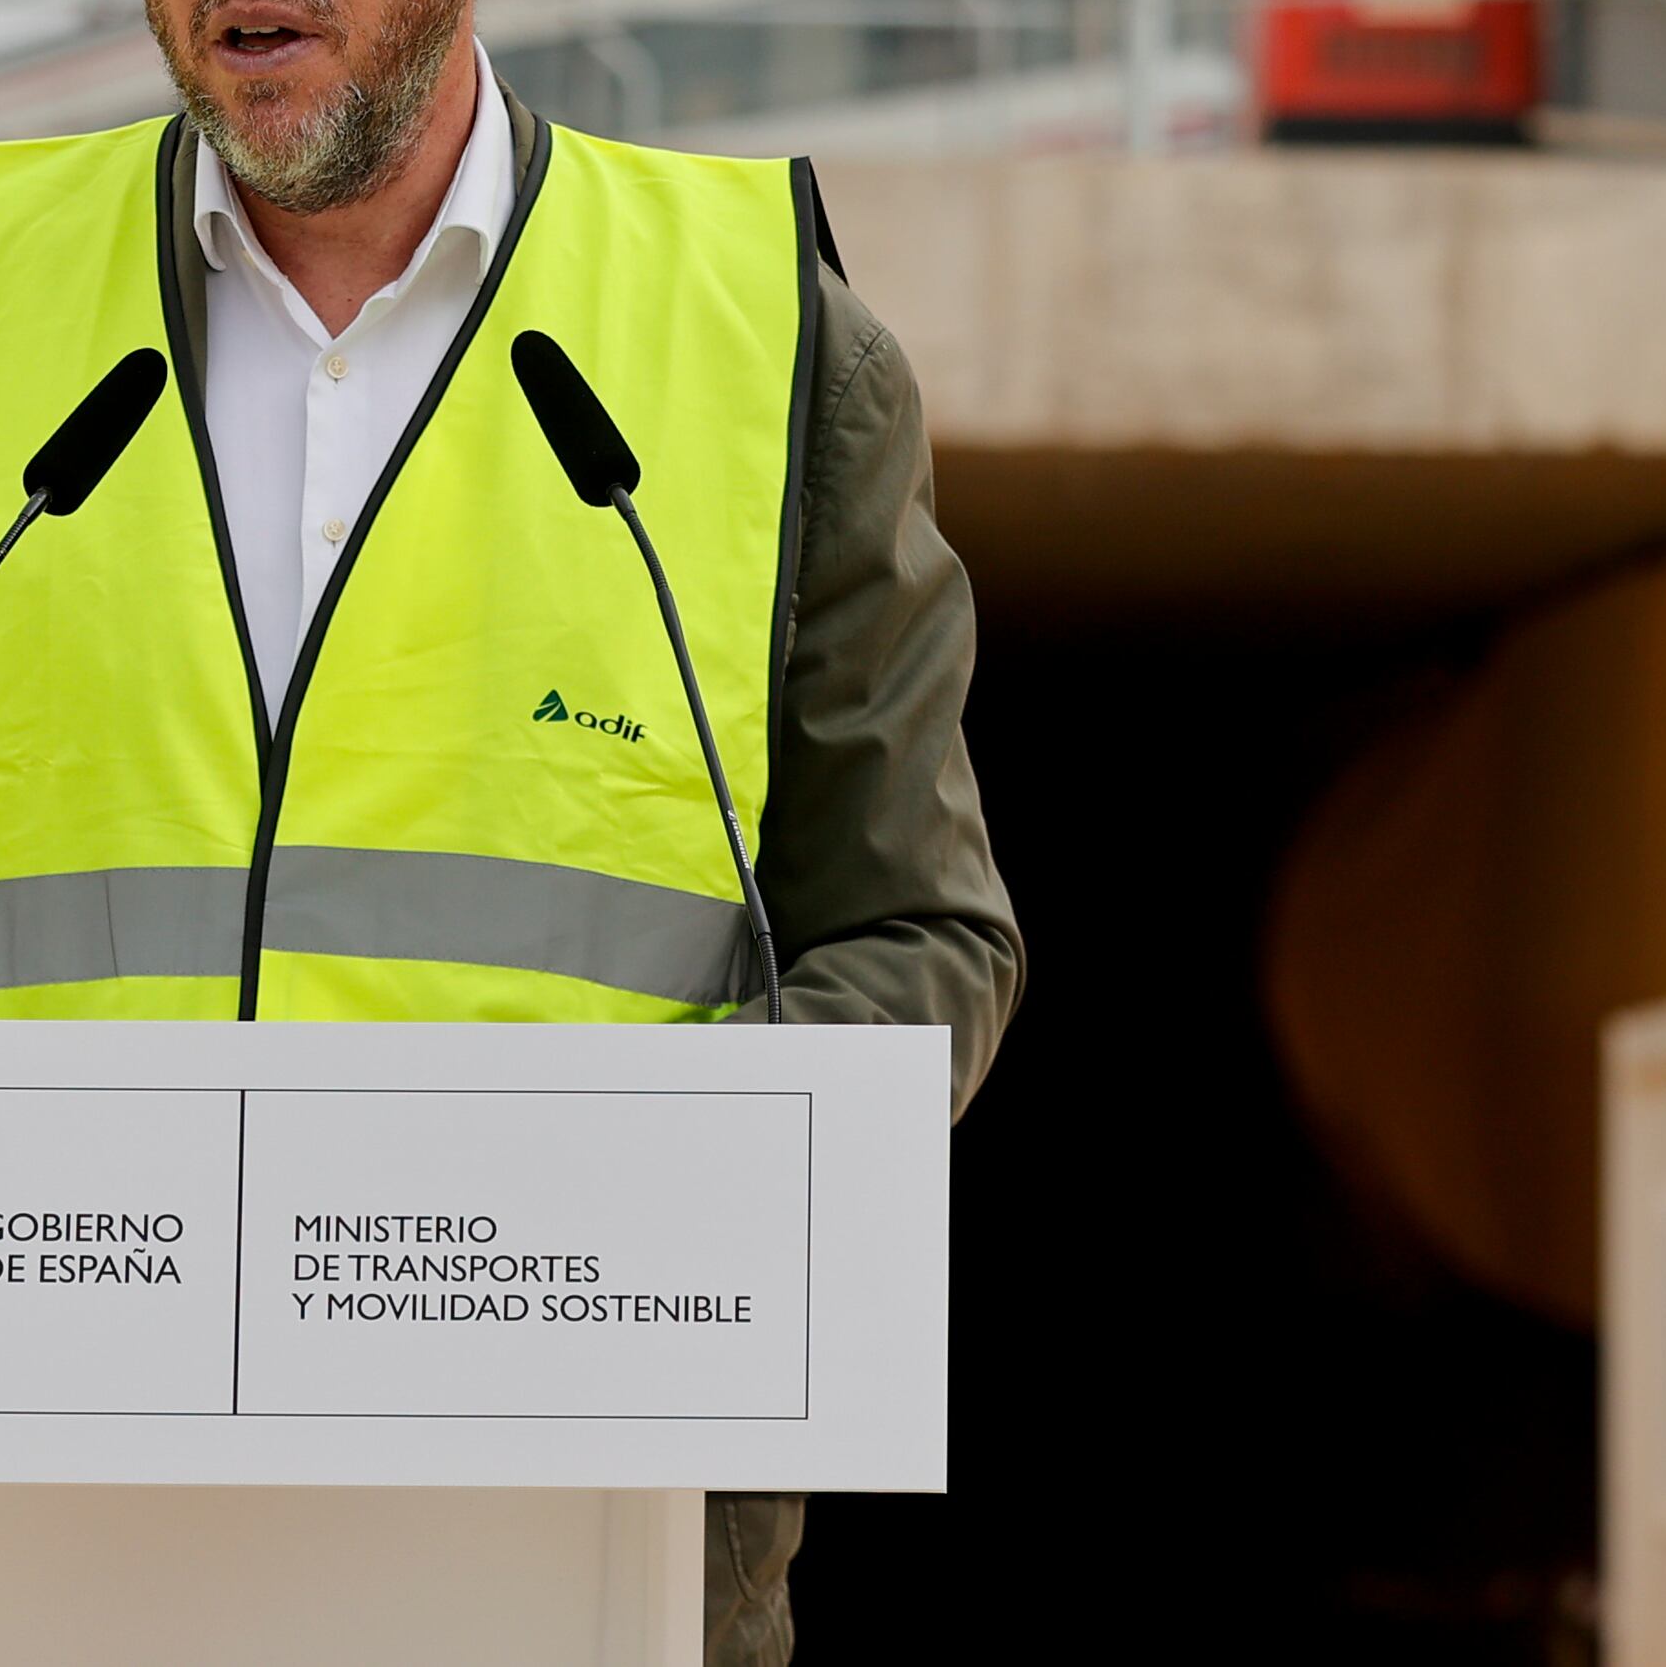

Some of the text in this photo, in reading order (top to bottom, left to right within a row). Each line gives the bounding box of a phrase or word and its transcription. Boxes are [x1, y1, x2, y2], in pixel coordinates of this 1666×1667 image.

[573, 711, 647, 744] adif
[294, 1215, 497, 1244] MINISTERIO
[39, 1247, 182, 1285] ESPAÑA
[294, 1253, 600, 1283] DE TRANSPORTES
[291, 1293, 752, 1323] Y MOVILIDAD SOSTENIBLE
